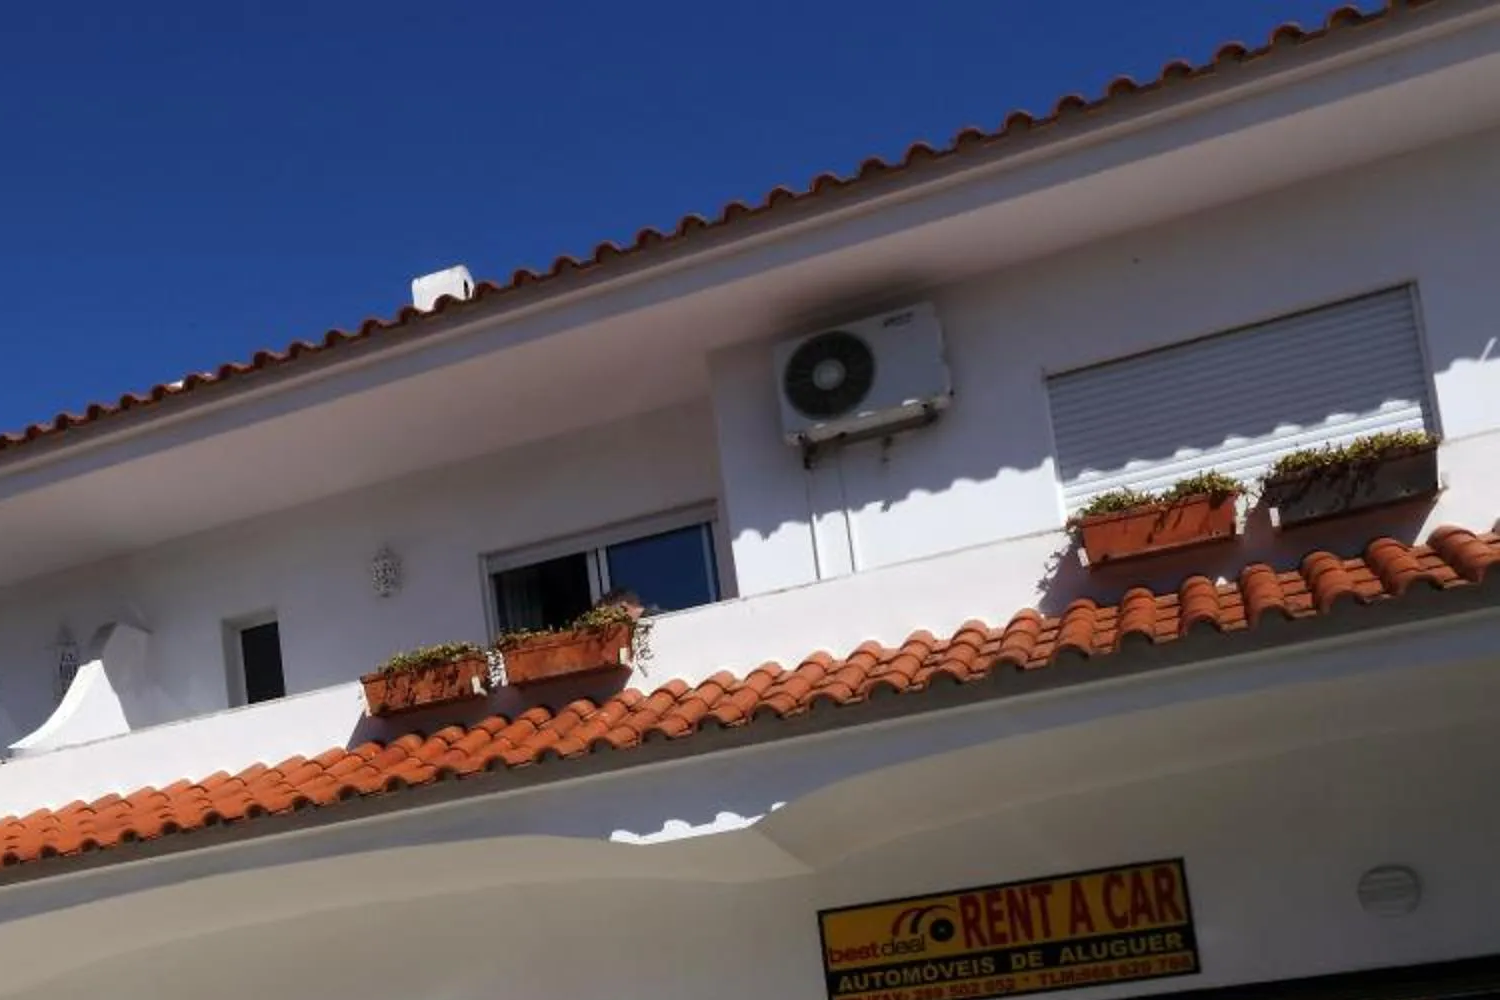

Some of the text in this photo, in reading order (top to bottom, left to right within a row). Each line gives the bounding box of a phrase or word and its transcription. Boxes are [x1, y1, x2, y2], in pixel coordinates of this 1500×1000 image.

[960, 865, 1185, 950] RENT A CAR
[838, 930, 1185, 994] AUTOMÓVEIS DE ALUGUER
